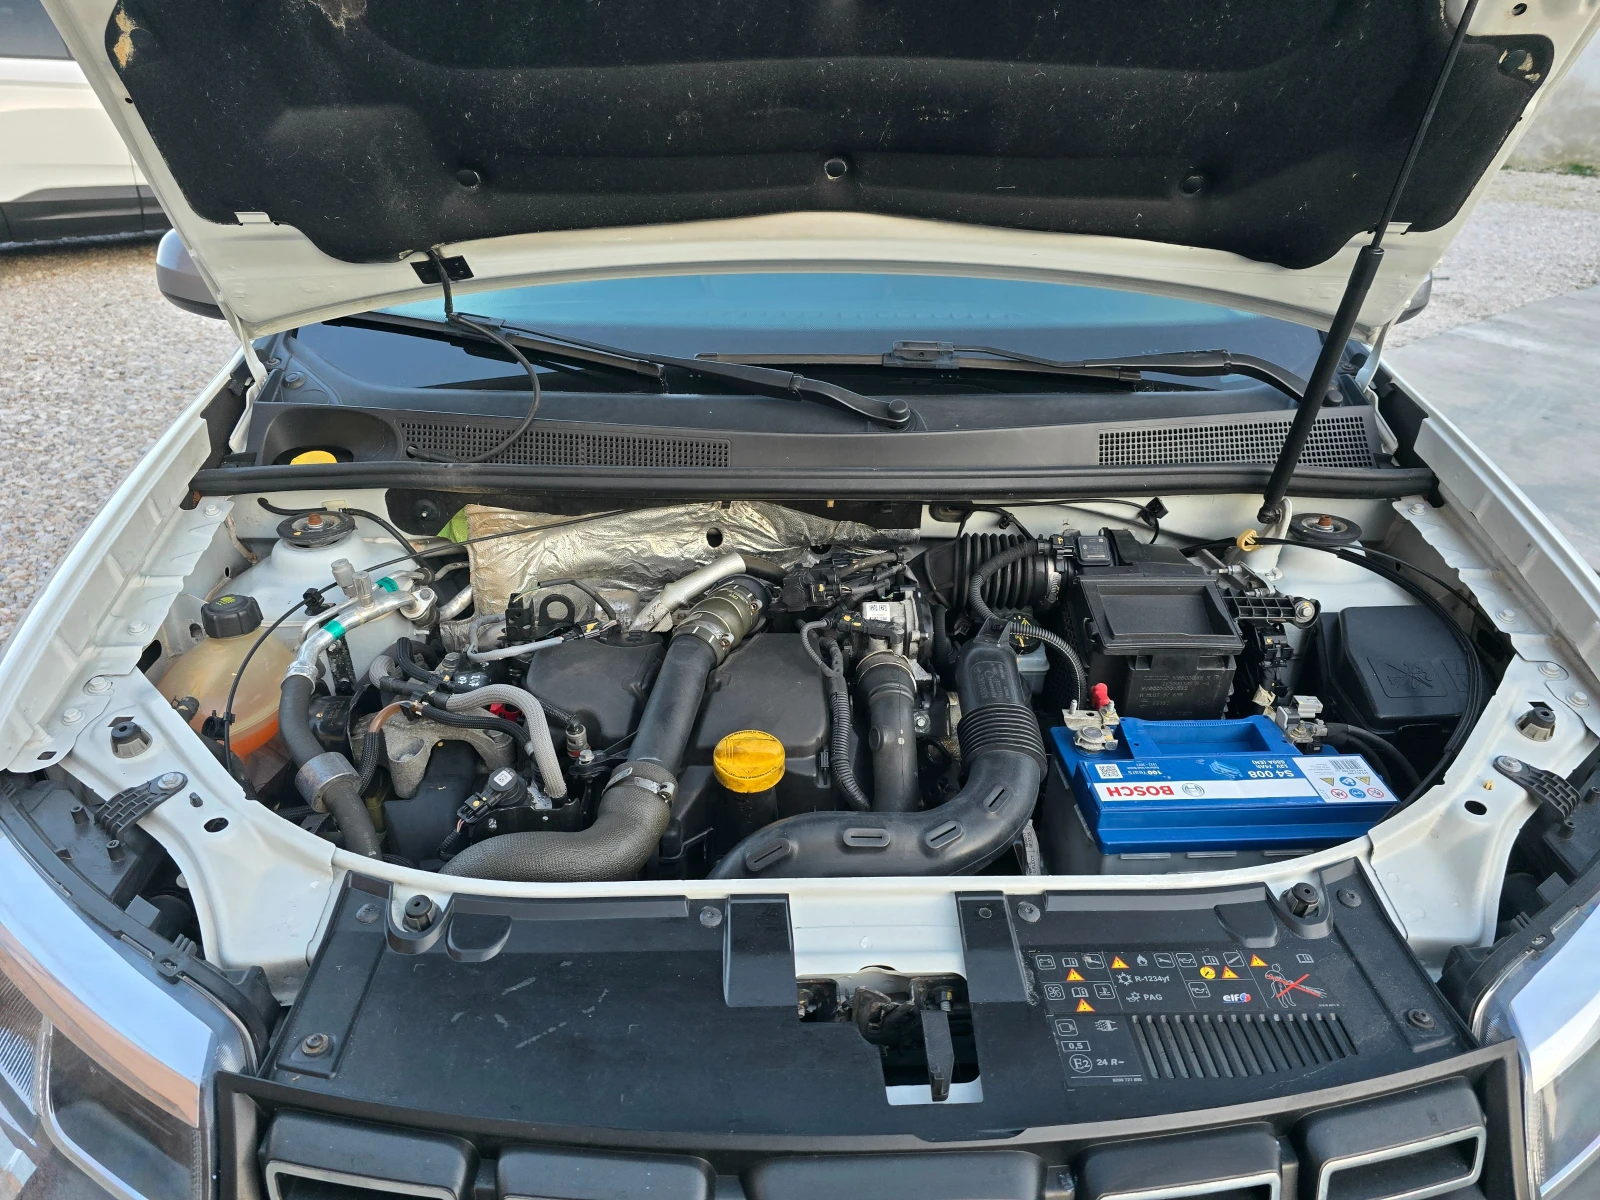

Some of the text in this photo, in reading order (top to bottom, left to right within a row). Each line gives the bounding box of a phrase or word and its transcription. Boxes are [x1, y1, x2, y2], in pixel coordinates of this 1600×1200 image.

[1247, 769, 1295, 778] S4 008
[1105, 785, 1175, 797] BOSCH
[1134, 975, 1171, 984] R-1234yf
[1143, 993, 1163, 1001] PAG
[1222, 993, 1241, 1002] elf
[1068, 1042, 1084, 1050] 0,5
[1072, 1058, 1091, 1070] E2
[1096, 1058, 1108, 1066] 24
